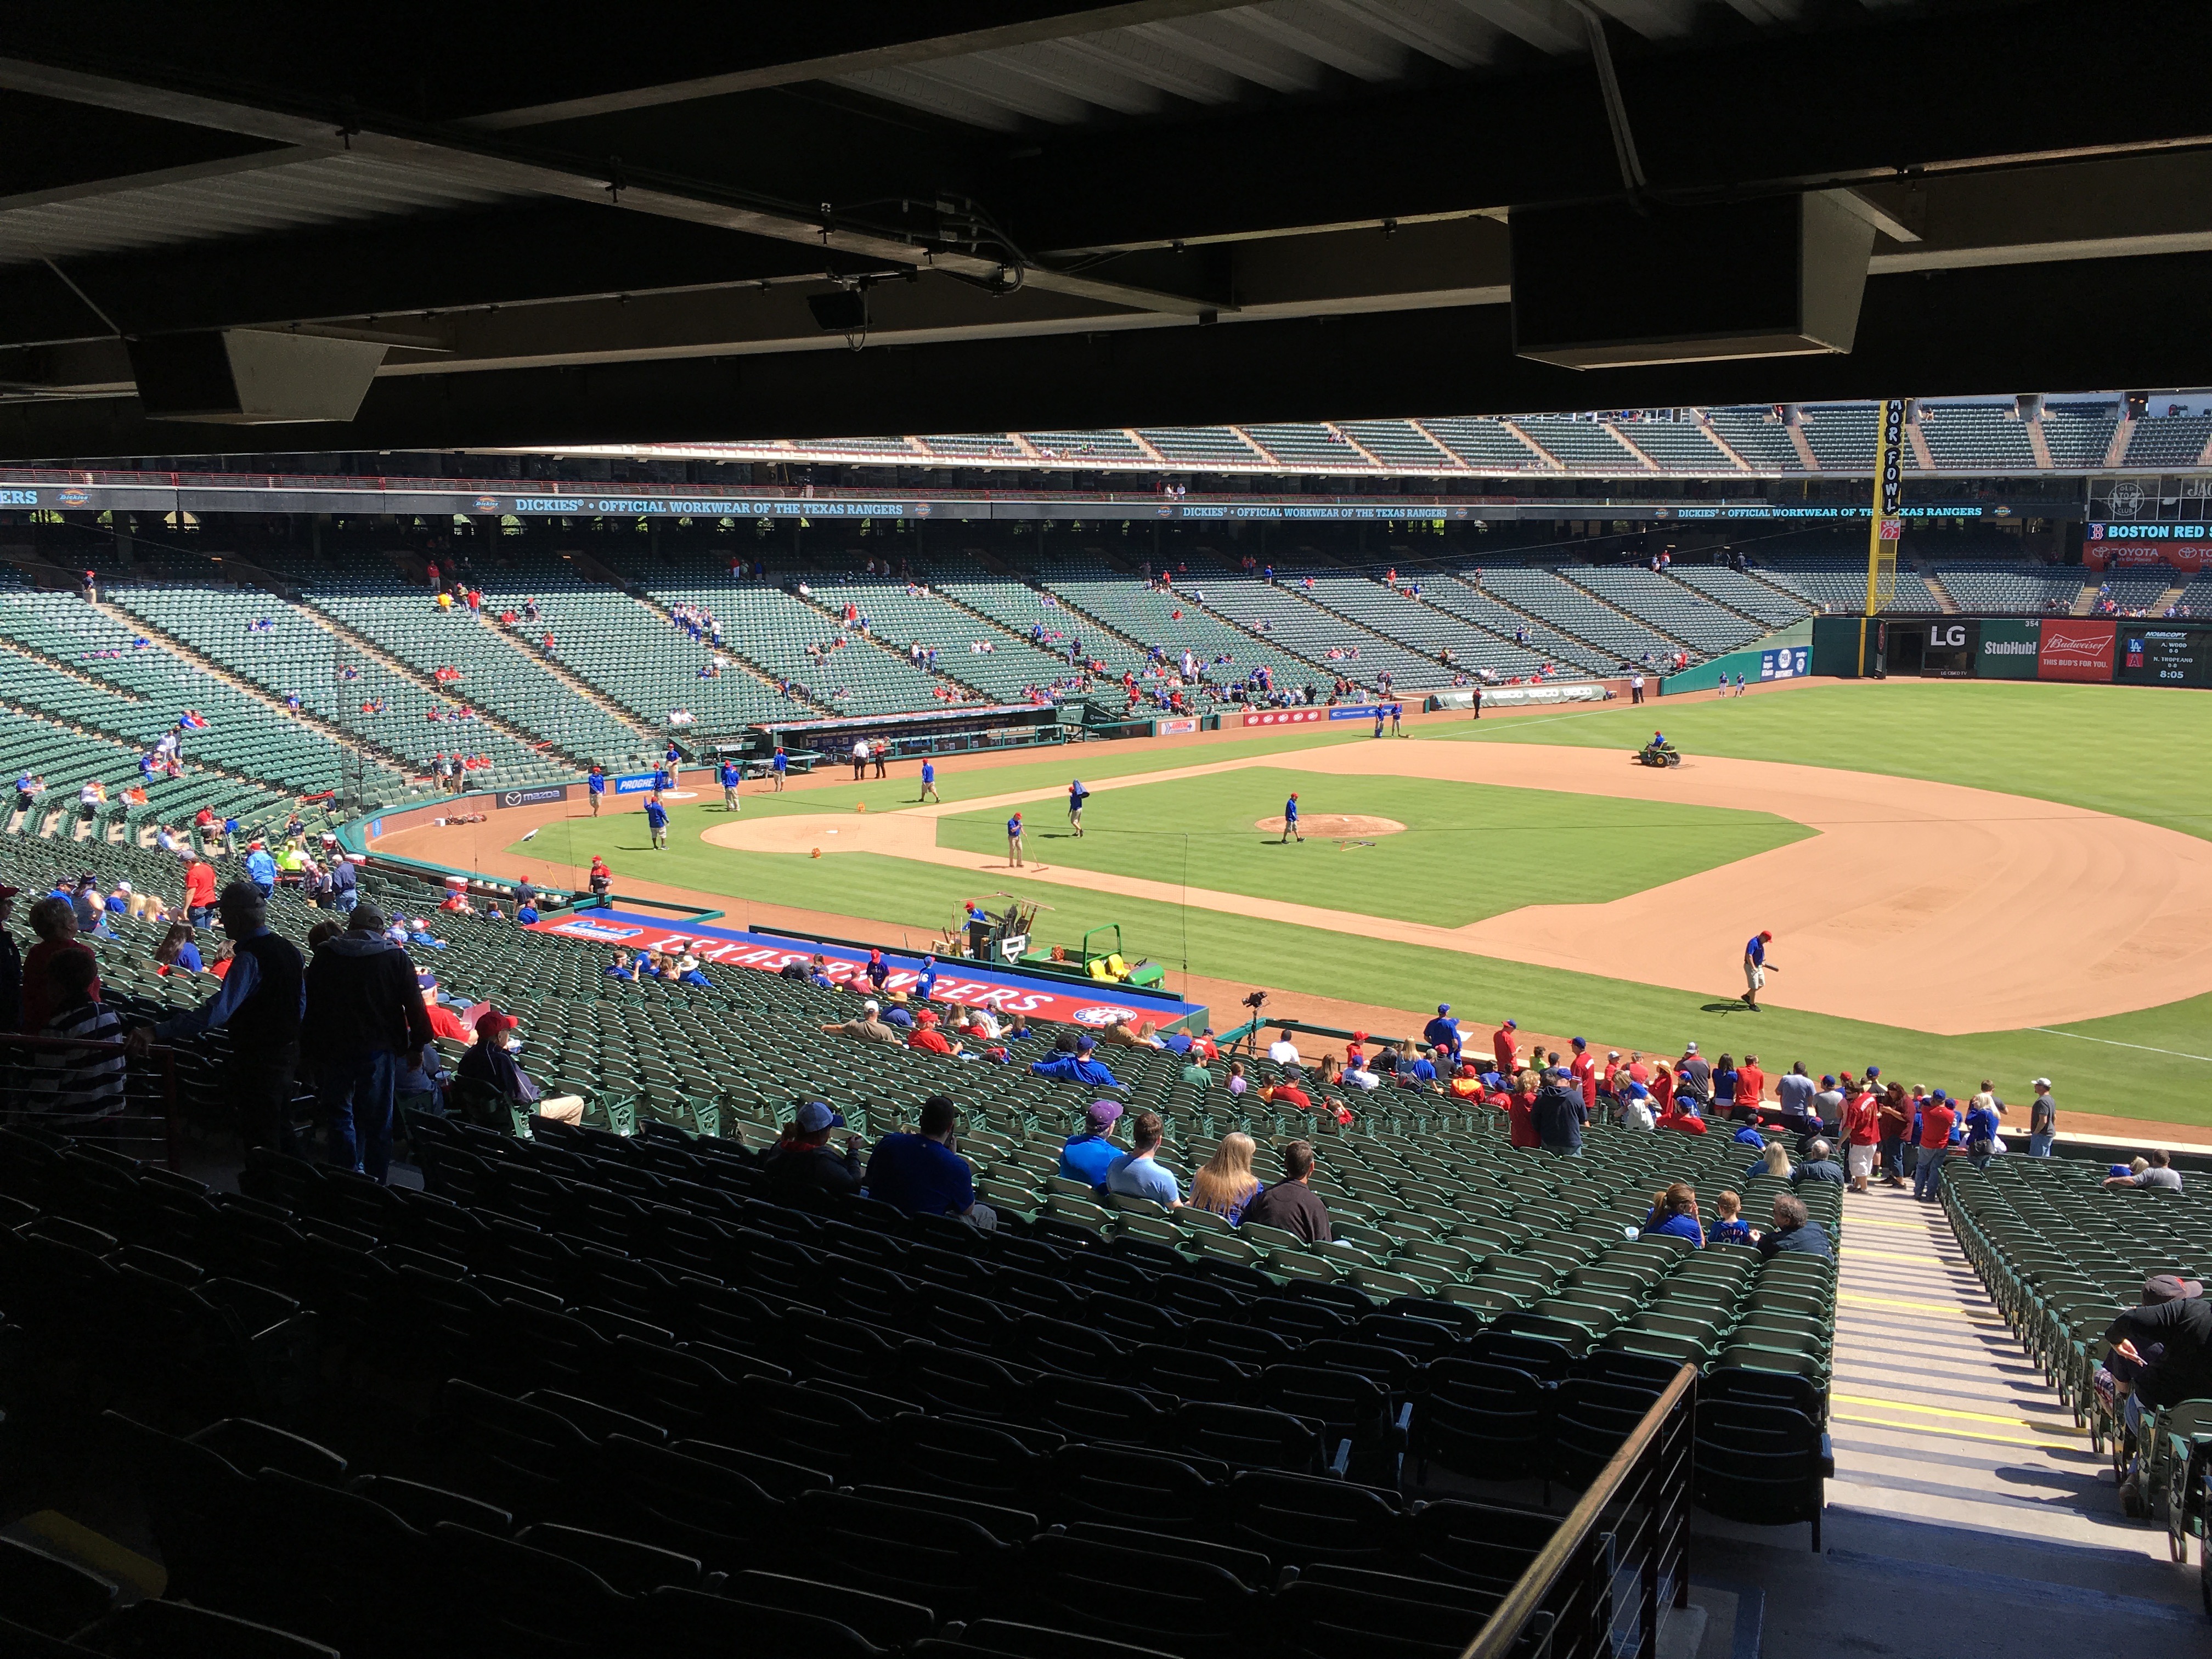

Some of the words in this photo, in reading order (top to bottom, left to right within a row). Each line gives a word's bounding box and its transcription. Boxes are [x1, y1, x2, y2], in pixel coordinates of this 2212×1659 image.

[1886, 450, 1898, 512] FOWL
[599, 500, 667, 512] OFFICIAL
[669, 501, 751, 514] WORKWEAR
[753, 503, 771, 514] OF
[774, 503, 800, 514] THE
[803, 504, 844, 515] TEXAS
[847, 504, 903, 515] RANGERS
[1237, 507, 1282, 517] OFFICIAL
[1284, 508, 1339, 517] WORKWEAR
[1341, 509, 1353, 517] OF
[1356, 509, 1374, 517] THE
[1376, 509, 1405, 517] TEXAS
[1407, 509, 1447, 517] RANGERS
[1728, 509, 1770, 517] OFFICIAL
[1773, 509, 1838, 517] WORKWEAR
[1841, 508, 1857, 516] OF
[1894, 508, 1924, 516] XAS
[1927, 507, 1982, 516] RANGERS
[2108, 526, 2170, 538] BOSTON
[2174, 526, 2204, 538] RED
[1931, 625, 1966, 646] LG
[1984, 641, 2037, 655] StubHub!
[2049, 638, 2104, 650] Budweiser
[2130, 639, 2142, 652] LA
[2159, 670, 2184, 679] 8:05
[648, 934, 809, 968] TEXAS
[827, 962, 1054, 1011] RNGERS
